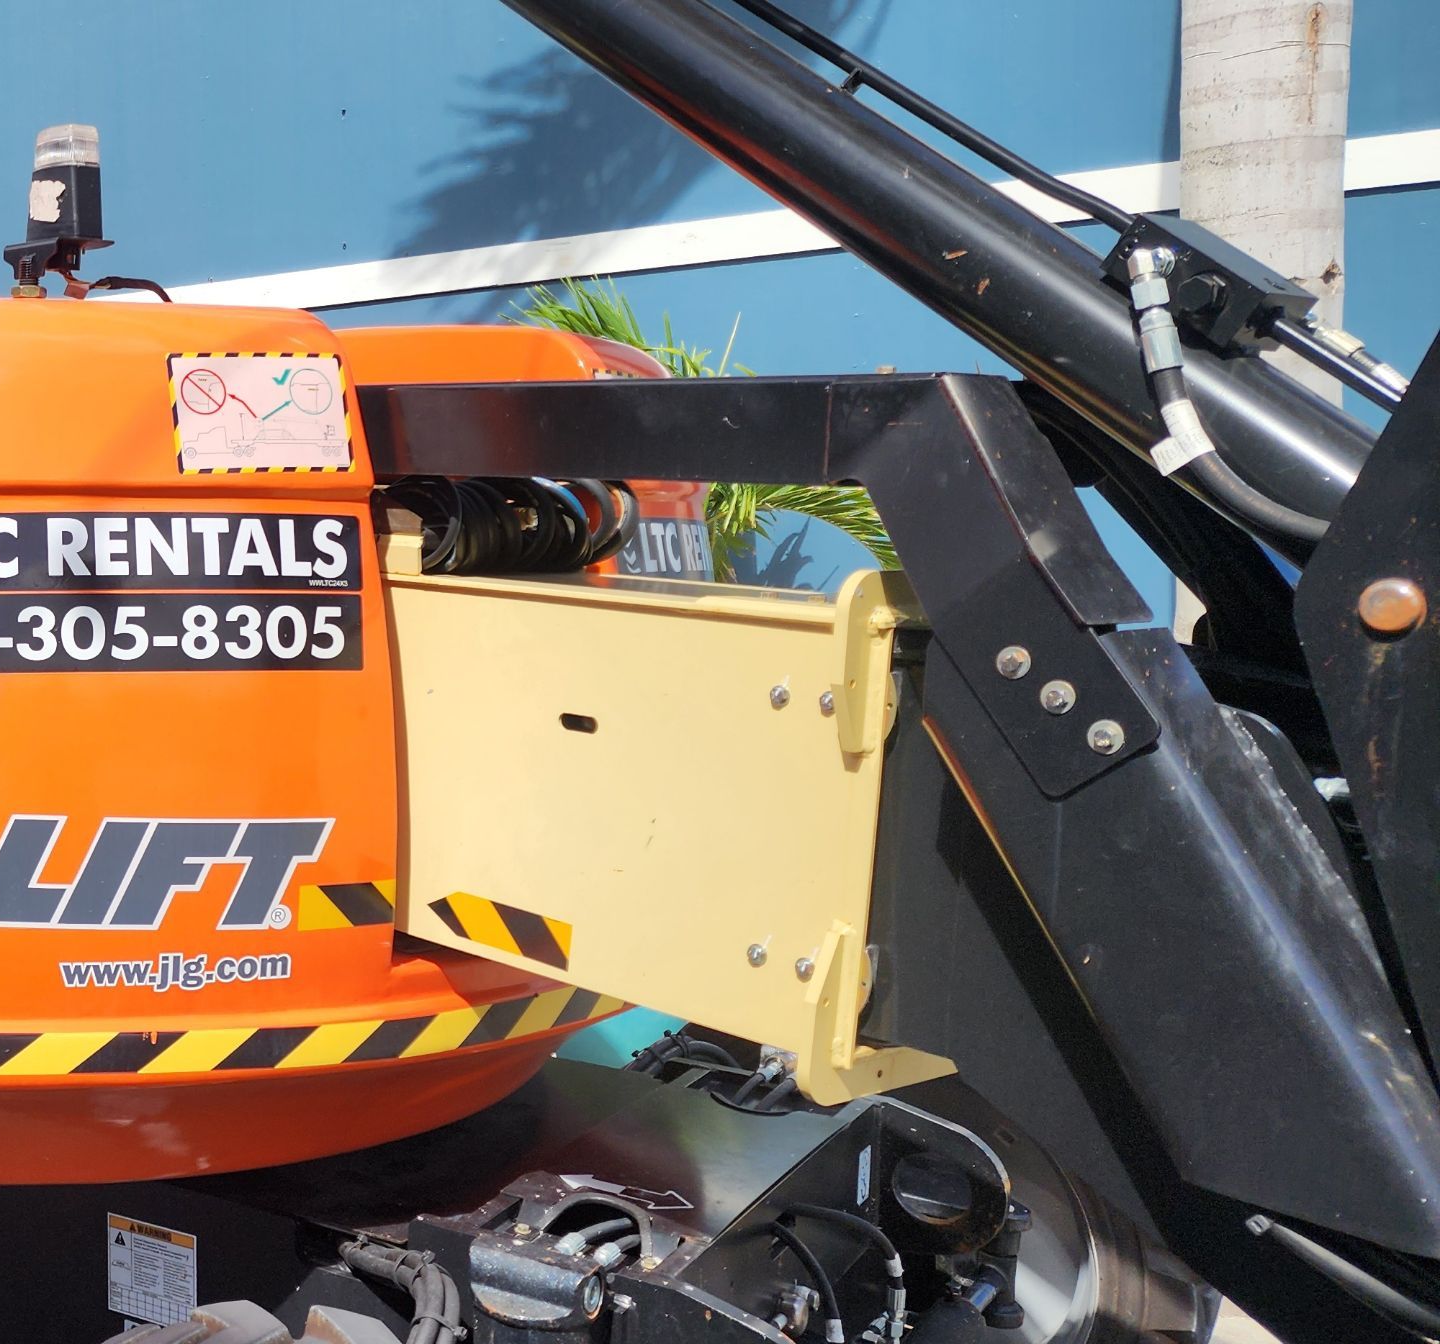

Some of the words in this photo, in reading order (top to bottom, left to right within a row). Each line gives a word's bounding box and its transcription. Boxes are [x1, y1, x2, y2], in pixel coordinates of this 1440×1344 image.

[45, 516, 349, 580] RENTALS
[638, 522, 682, 573] LTC
[59, 952, 292, 992] www.jlg.com
[135, 1223, 172, 1243] WARNING
